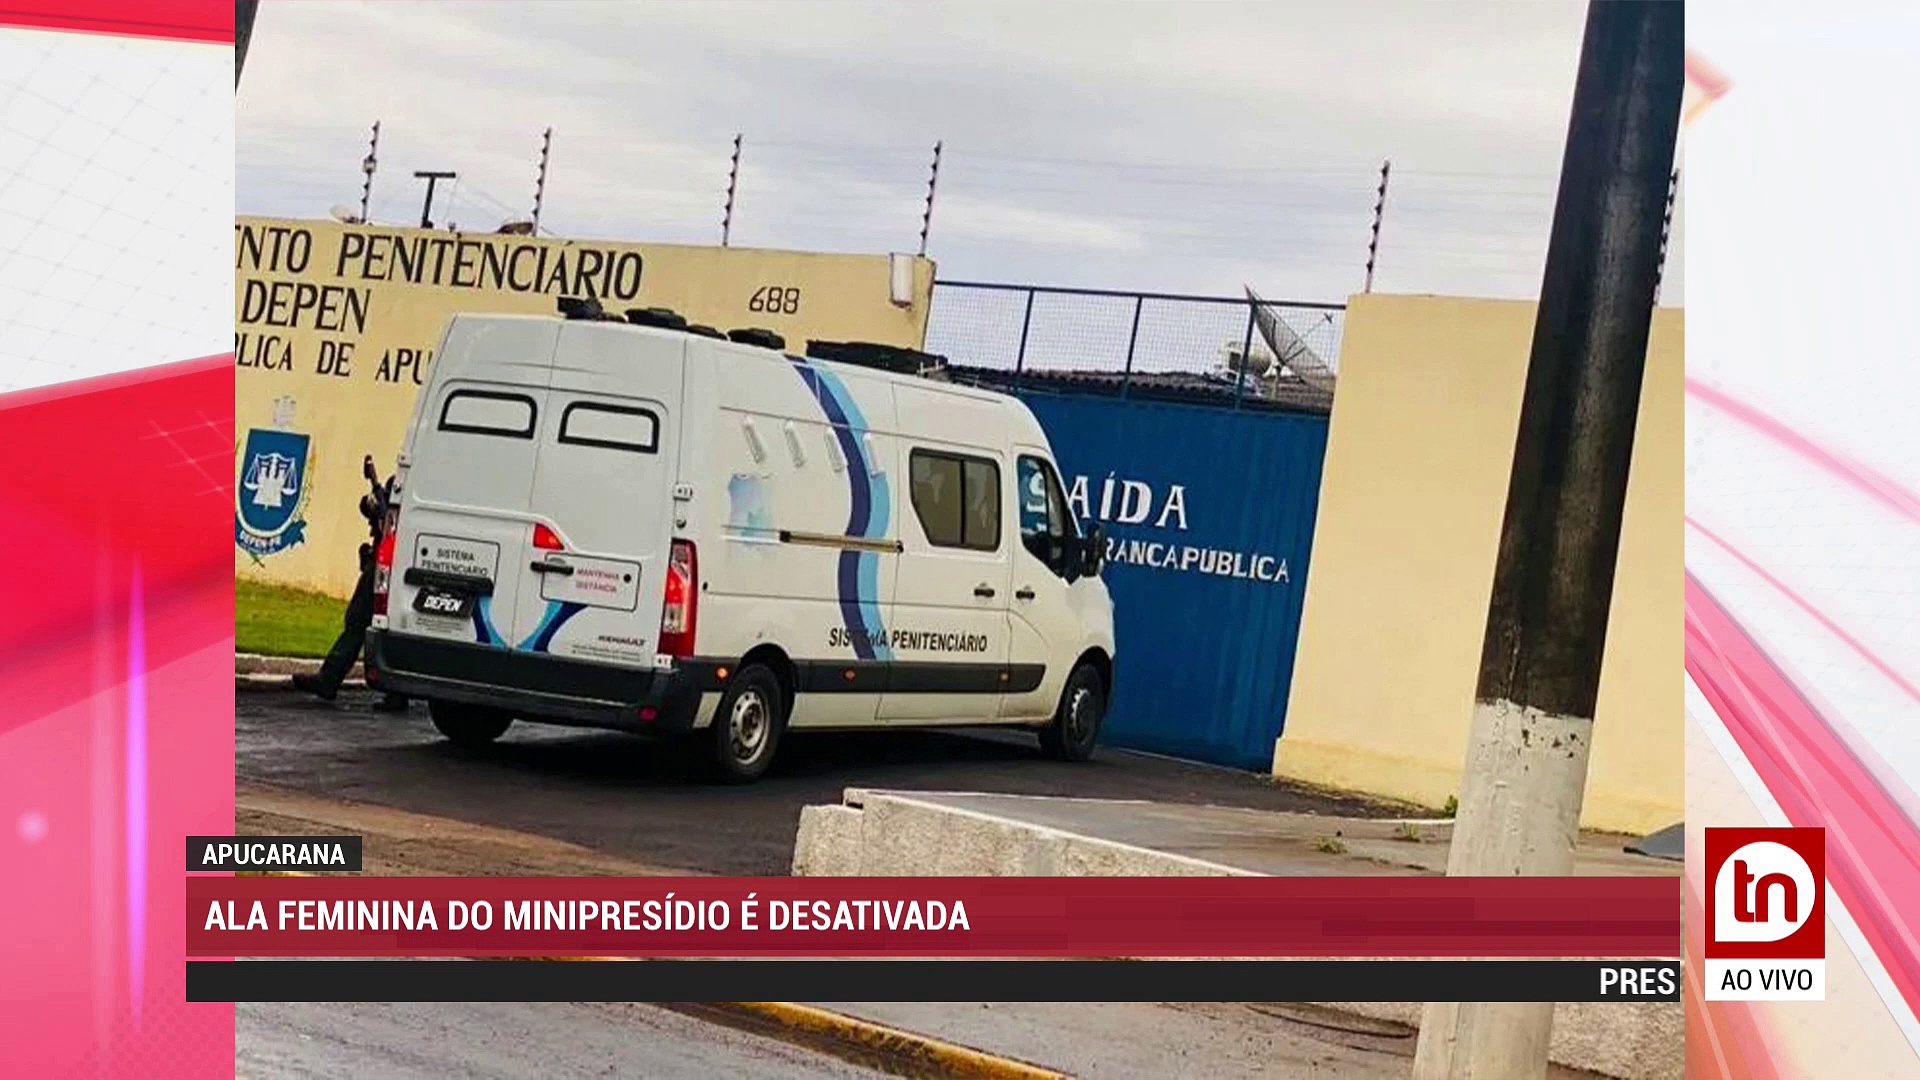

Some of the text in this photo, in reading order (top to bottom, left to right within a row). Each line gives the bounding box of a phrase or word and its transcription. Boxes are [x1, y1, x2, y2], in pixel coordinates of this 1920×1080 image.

[235, 224, 644, 300] NTO PENITENCIÁRIO
[241, 279, 371, 334] DEPEN
[749, 286, 799, 314] 688
[316, 340, 355, 377] DE
[437, 547, 475, 561] SISTEMA
[424, 595, 463, 612] DEPEN
